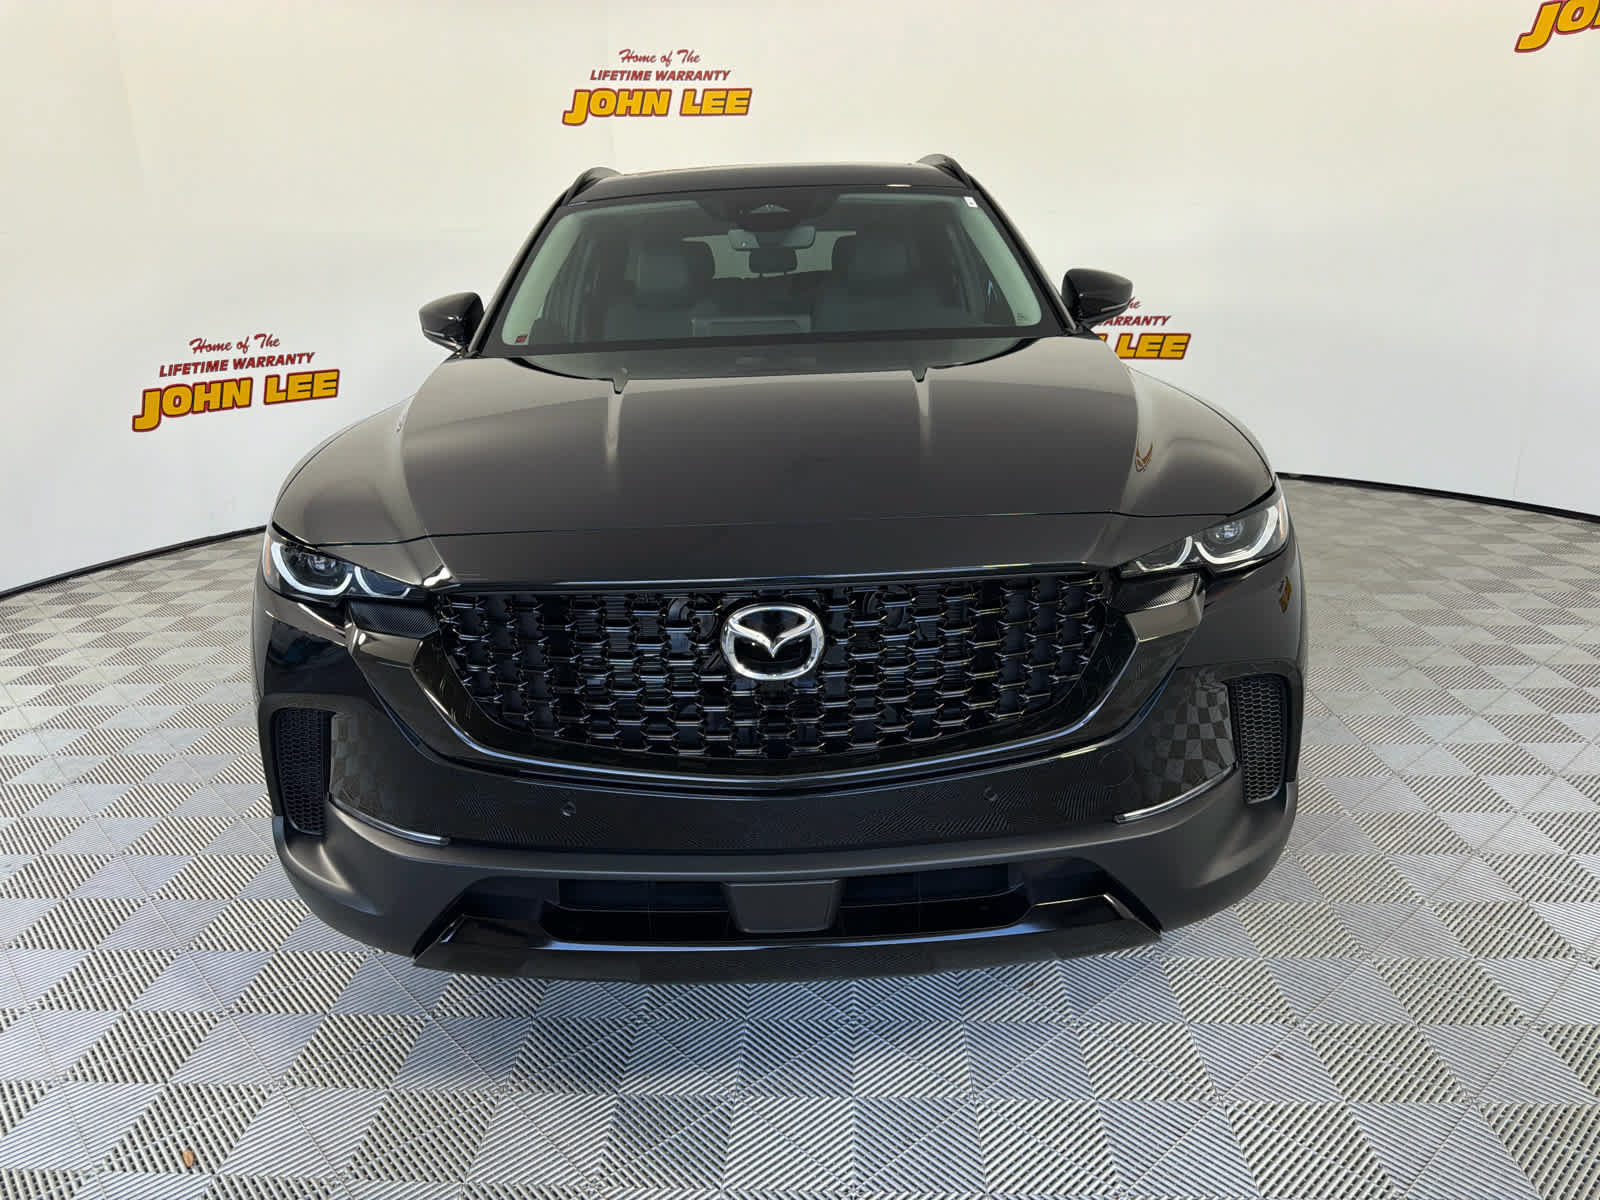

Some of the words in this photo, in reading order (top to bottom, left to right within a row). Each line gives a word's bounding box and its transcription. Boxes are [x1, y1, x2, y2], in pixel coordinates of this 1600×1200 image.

[1514, 0, 1600, 53] JO
[618, 48, 657, 64] Home
[660, 50, 673, 67] of
[676, 48, 701, 64] The
[589, 69, 652, 81] LIFETIME
[655, 69, 731, 81] WARRANTY
[562, 87, 673, 127] JOHN
[679, 88, 752, 117] LEE
[1097, 315, 1172, 326] ARRANTY
[188, 337, 233, 355] Home
[236, 336, 250, 354] of
[253, 333, 281, 349] The
[1114, 332, 1192, 360] LEE
[159, 358, 229, 378] LIFETIME
[232, 351, 316, 371] WARRANTY
[132, 376, 254, 433] JOHN
[263, 368, 340, 406] LEE
